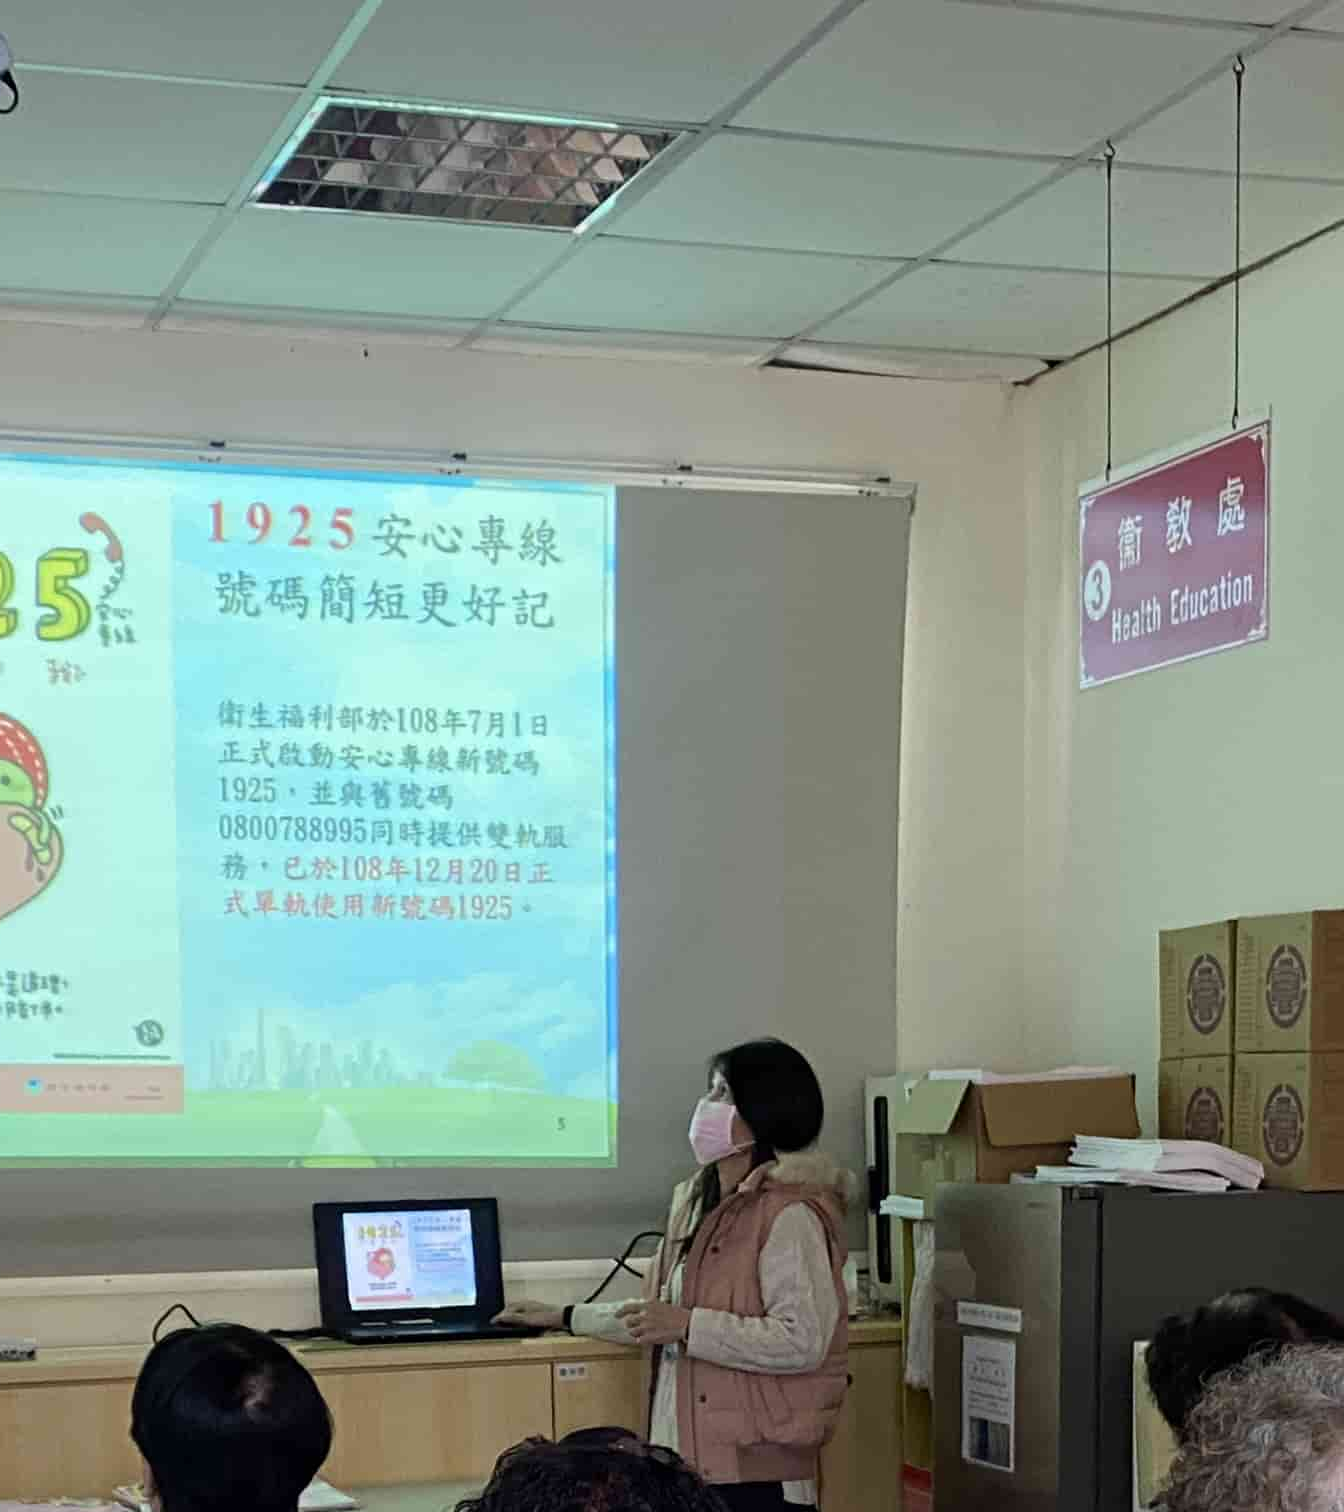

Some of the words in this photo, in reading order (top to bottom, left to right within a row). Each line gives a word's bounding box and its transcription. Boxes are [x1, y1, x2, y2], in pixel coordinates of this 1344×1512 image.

[1117, 476, 1246, 571] 衛教處
[215, 570, 555, 628] 號碼簡短更好記
[1111, 596, 1161, 645] Health
[1170, 571, 1253, 625] Education
